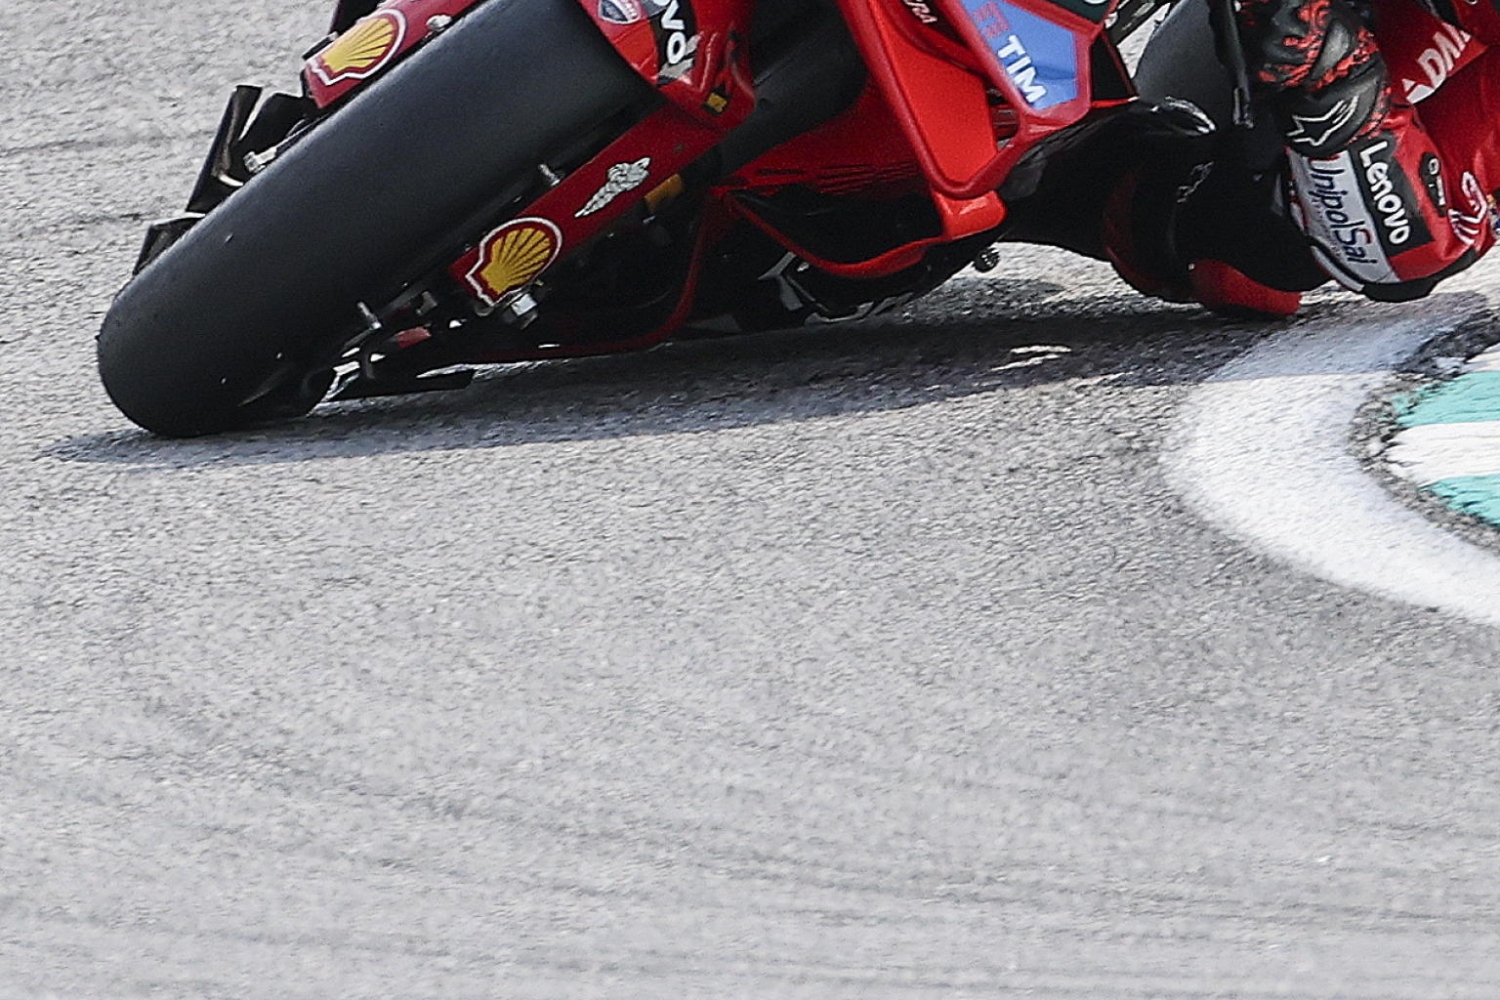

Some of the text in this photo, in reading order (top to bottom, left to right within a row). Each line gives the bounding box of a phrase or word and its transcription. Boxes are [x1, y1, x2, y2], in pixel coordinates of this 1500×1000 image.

[997, 34, 1048, 105] TIM
[1308, 161, 1379, 265] UnipolSai
[1360, 140, 1411, 245] Lenovo
